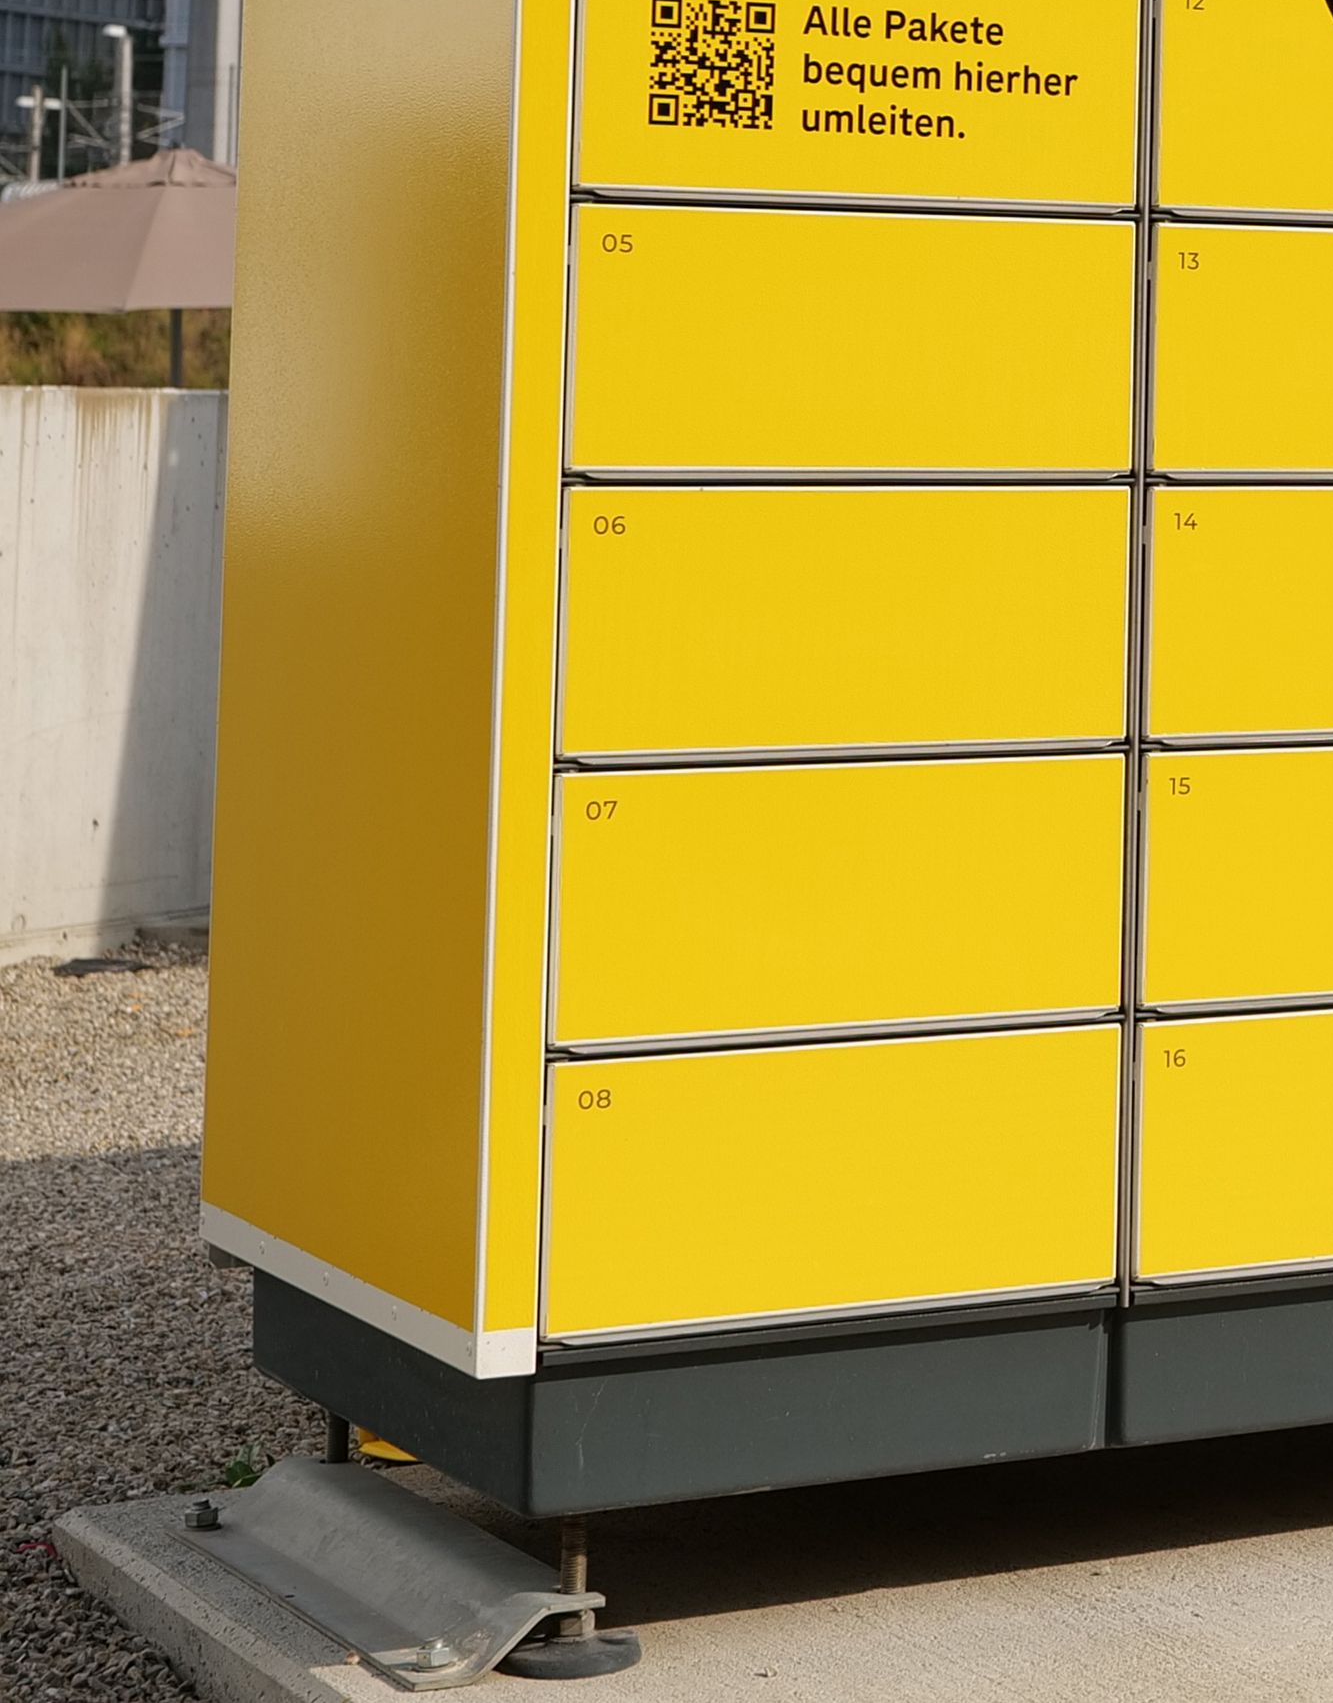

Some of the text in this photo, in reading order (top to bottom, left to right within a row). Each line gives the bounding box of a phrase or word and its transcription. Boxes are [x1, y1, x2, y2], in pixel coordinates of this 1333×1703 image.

[803, 6, 1003, 45] Alle Pakete
[804, 54, 1078, 96] bequem hierher
[803, 104, 964, 138] umleiten.
[602, 234, 632, 253] 05
[1179, 252, 1199, 270] 13
[594, 515, 625, 534] 06
[1174, 513, 1197, 530] 14
[1169, 777, 1190, 795] 15
[586, 801, 617, 820] 07
[1164, 1049, 1185, 1067] 16
[579, 1089, 611, 1109] 08
